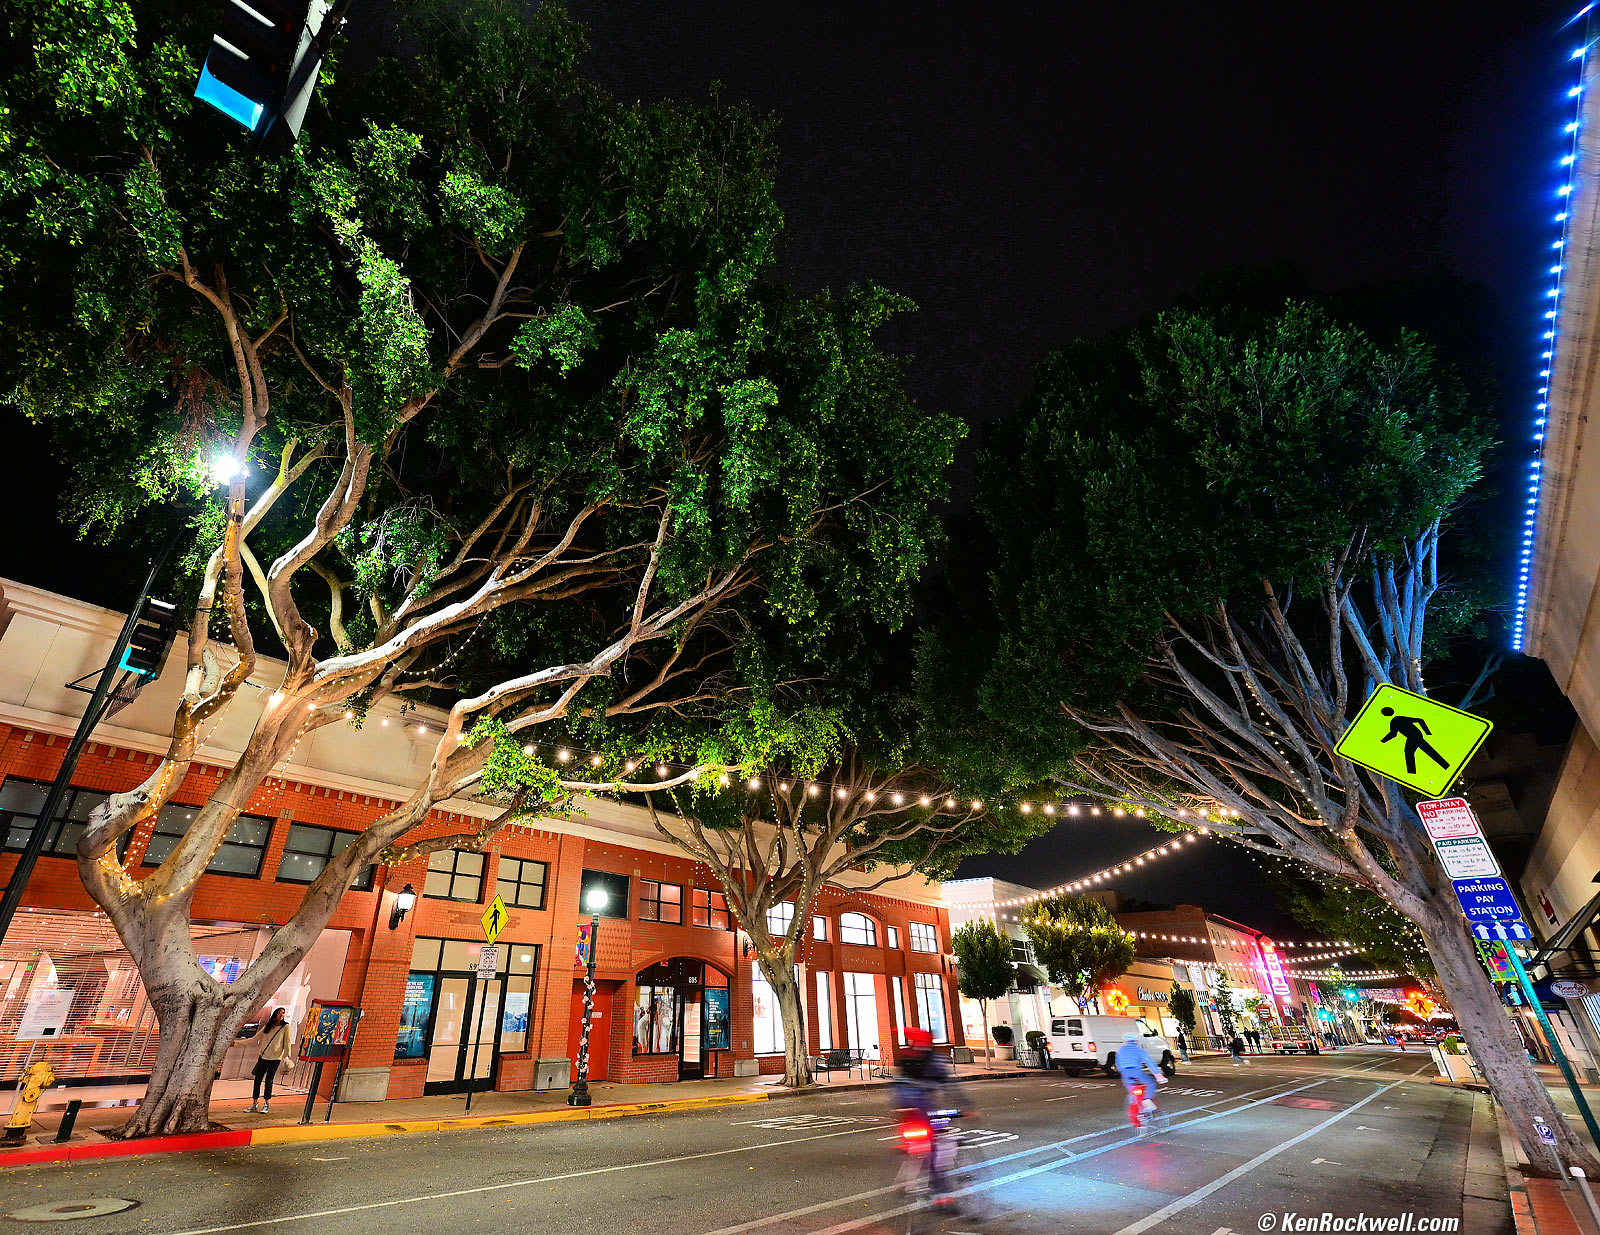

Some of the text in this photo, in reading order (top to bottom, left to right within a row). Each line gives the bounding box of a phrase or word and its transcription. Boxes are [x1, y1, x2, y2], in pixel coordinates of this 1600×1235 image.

[1421, 800, 1460, 810] TOW-AWAY
[1457, 883, 1504, 893] PARKING
[1475, 895, 1494, 903] PAY
[1469, 905, 1514, 915] STATION
[469, 962, 480, 971] 89
[1541, 1126, 1549, 1135] P
